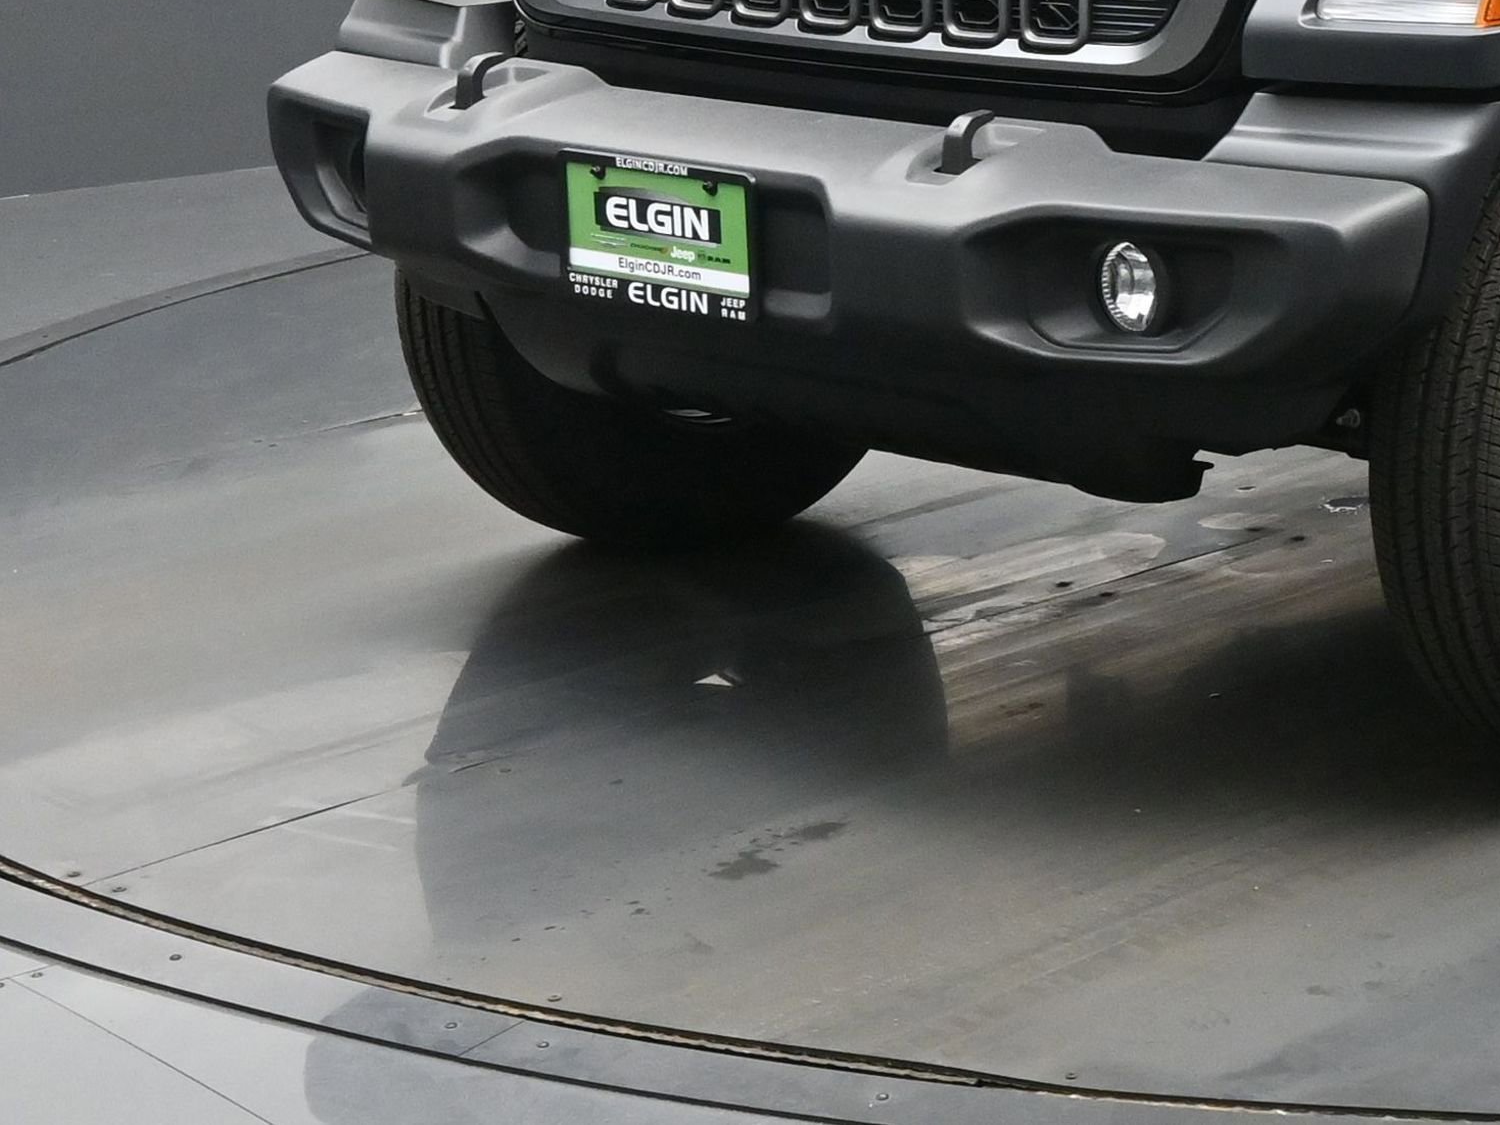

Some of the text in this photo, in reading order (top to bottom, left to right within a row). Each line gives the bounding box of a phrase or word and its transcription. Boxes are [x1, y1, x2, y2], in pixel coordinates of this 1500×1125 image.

[615, 157, 689, 176] ELGINCDJR.COM
[606, 196, 710, 241] ELGIN
[670, 246, 696, 262] Jeep
[618, 257, 702, 281] ElginCDJR.com
[569, 272, 618, 288] CHRYSLER
[574, 285, 613, 299] DODGE
[628, 282, 708, 314] ELGIN
[720, 297, 746, 309] JEEP
[721, 308, 746, 321] RAM
